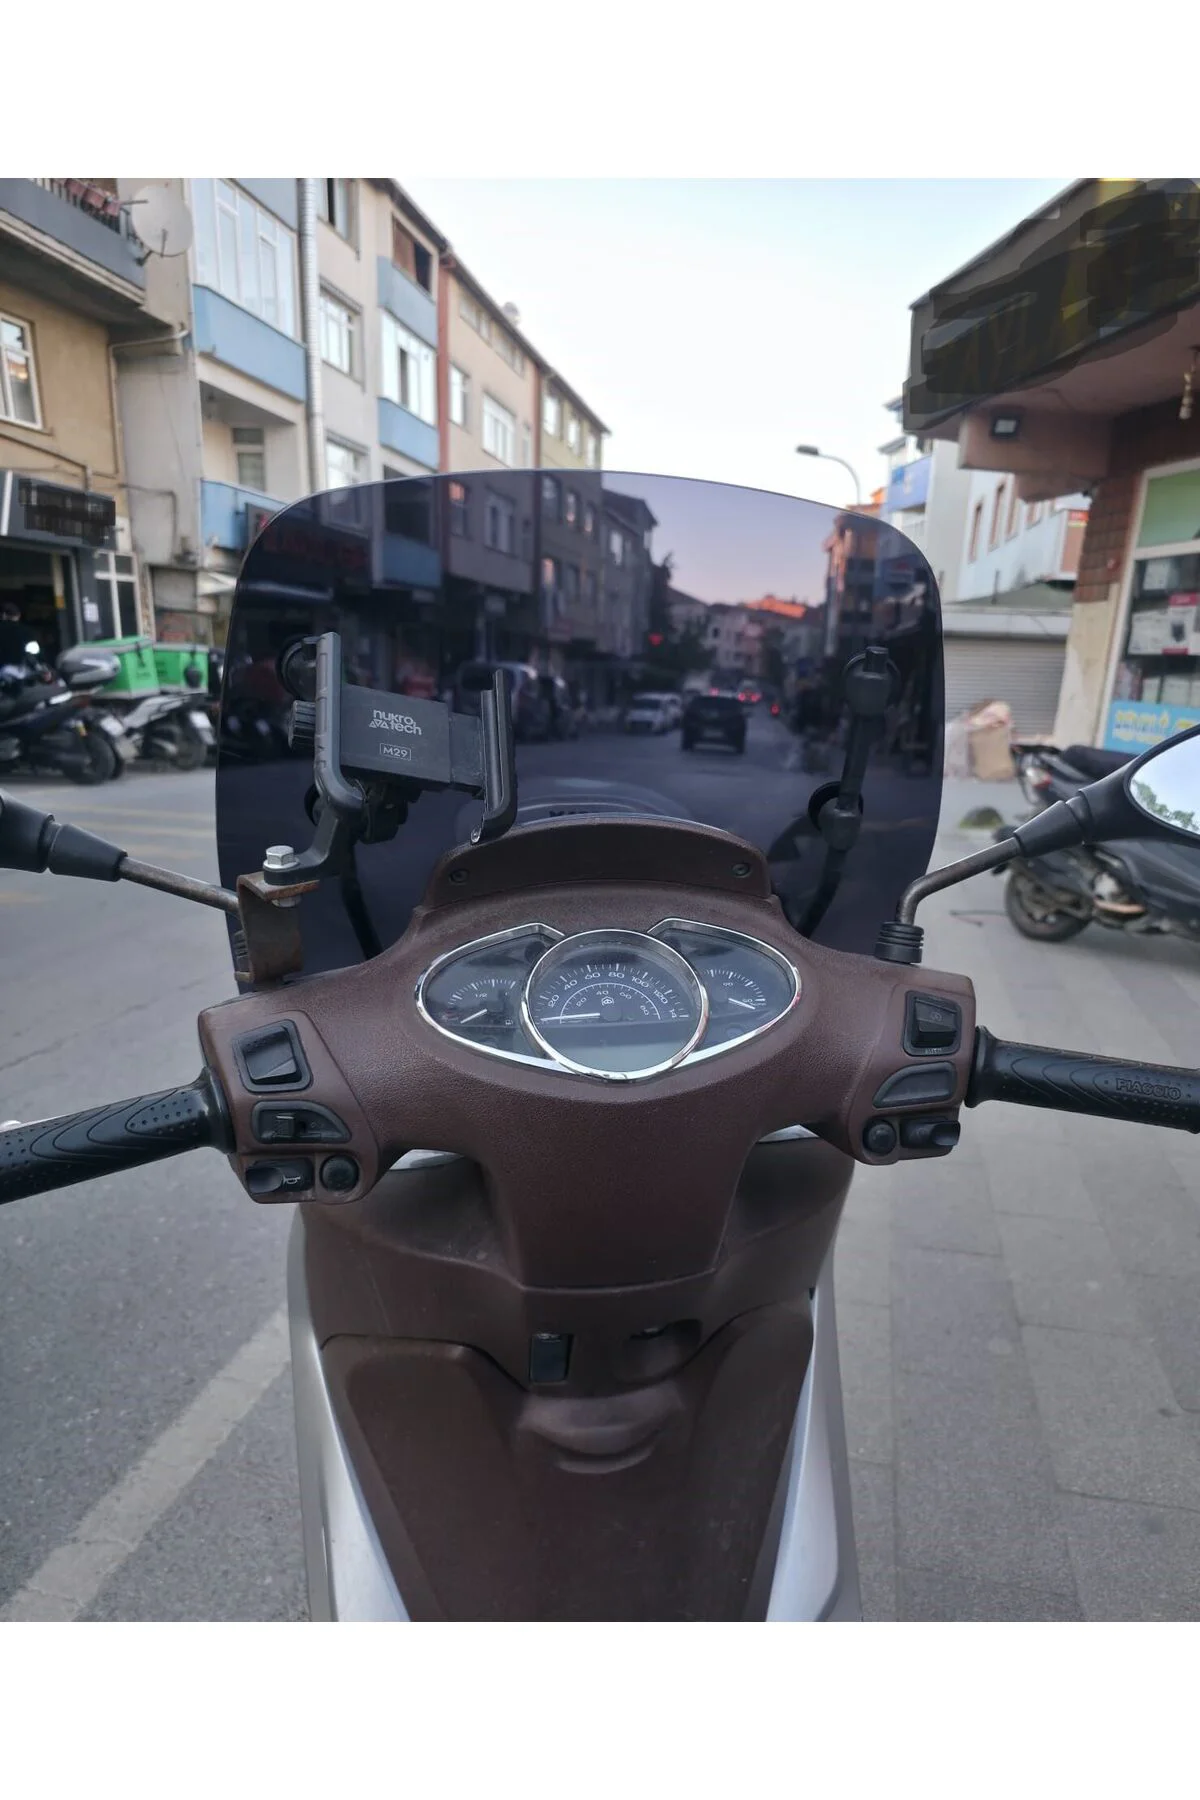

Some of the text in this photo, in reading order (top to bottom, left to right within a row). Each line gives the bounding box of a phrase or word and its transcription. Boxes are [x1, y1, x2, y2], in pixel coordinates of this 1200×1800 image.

[373, 709, 414, 725] nukro
[390, 720, 422, 735] tech
[383, 746, 408, 757] M29
[584, 971, 600, 980] 60
[608, 971, 625, 979] 80
[564, 979, 578, 990] 40
[631, 976, 650, 988] 100
[548, 994, 560, 1008] 20
[576, 997, 587, 1007] 20
[653, 989, 668, 1004] 120
[1115, 1078, 1181, 1100] PIAGGIO
